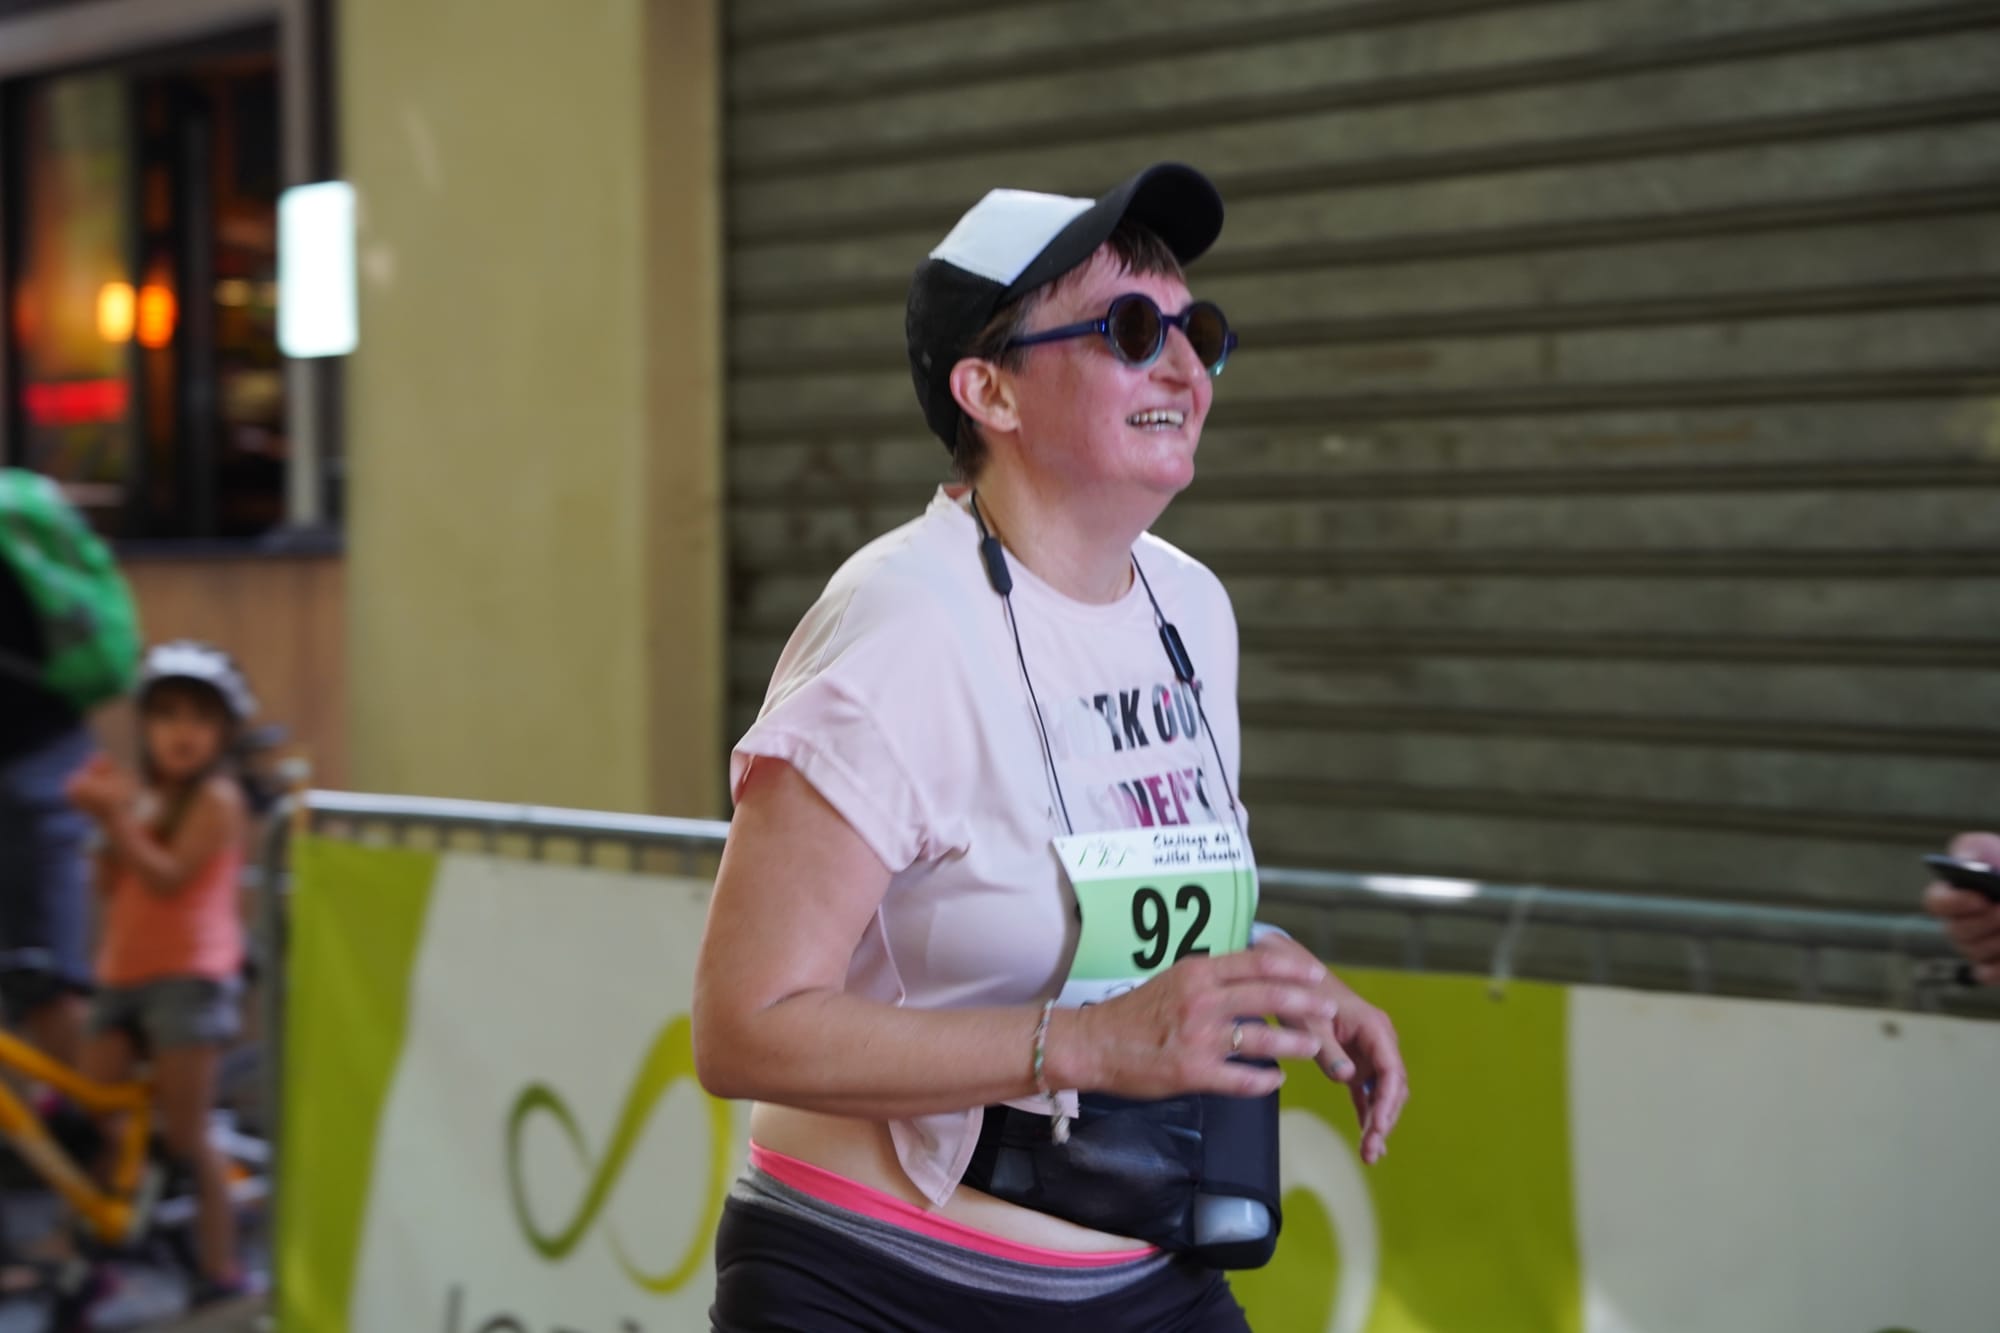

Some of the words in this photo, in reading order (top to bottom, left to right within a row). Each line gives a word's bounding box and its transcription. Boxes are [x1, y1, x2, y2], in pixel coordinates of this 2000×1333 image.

[1153, 833, 1208, 849] Challenge
[1215, 833, 1230, 844] des
[1132, 884, 1212, 970] 92
